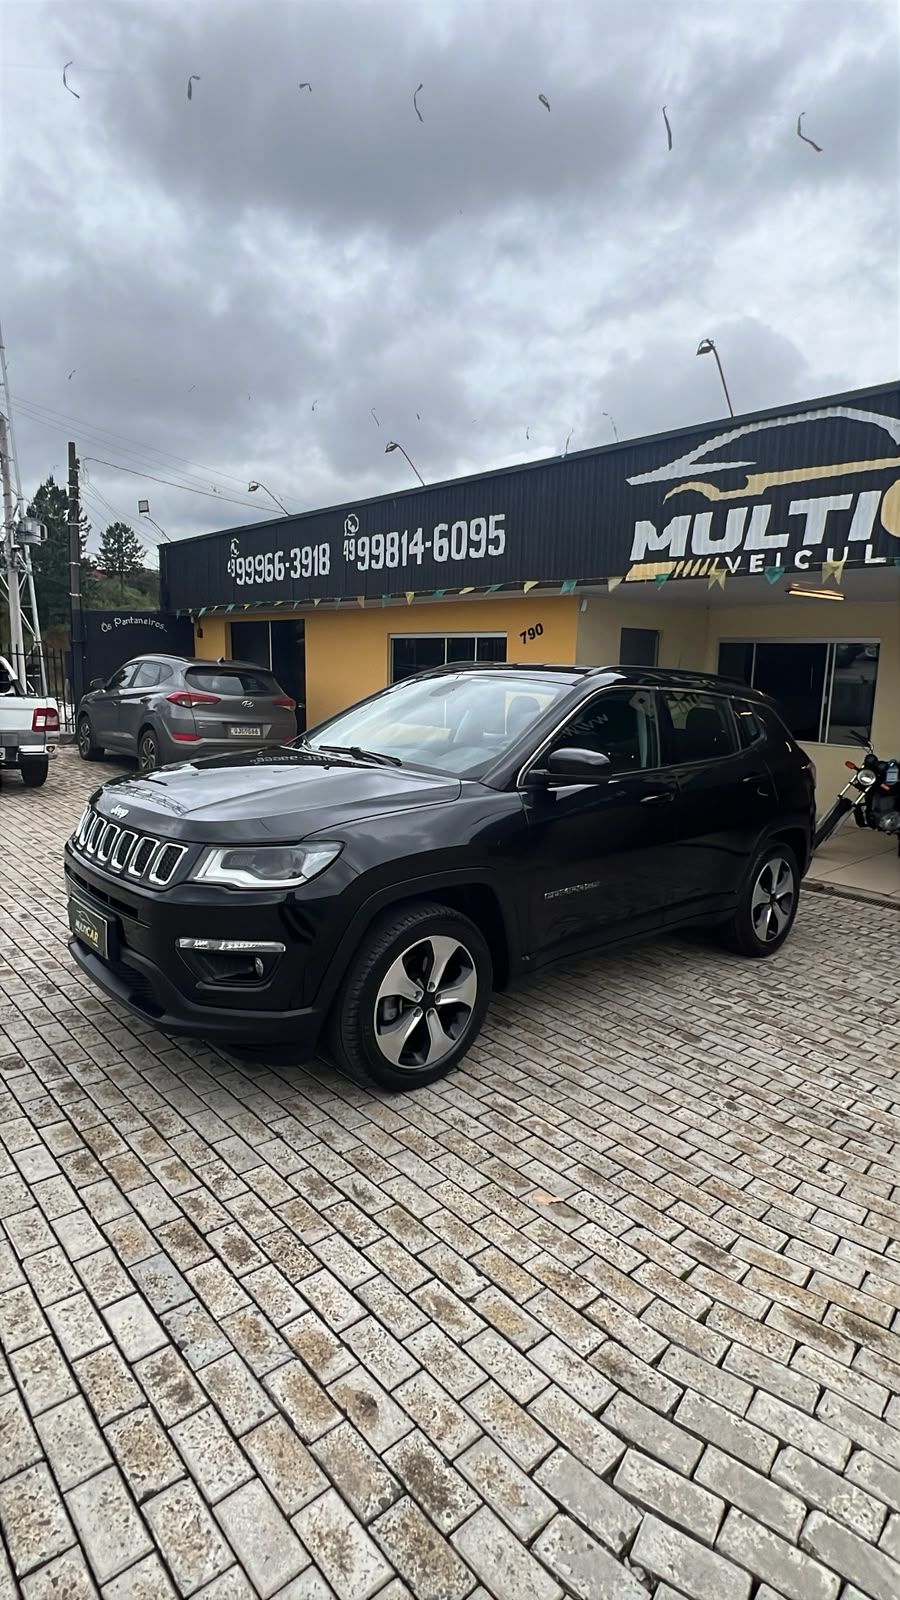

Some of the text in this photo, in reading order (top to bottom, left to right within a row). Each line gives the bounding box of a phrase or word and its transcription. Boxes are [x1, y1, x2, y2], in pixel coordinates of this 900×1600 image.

[236, 542, 331, 586] 99966-3918
[343, 513, 506, 571] 49 99814-6095
[519, 623, 544, 645] 790
